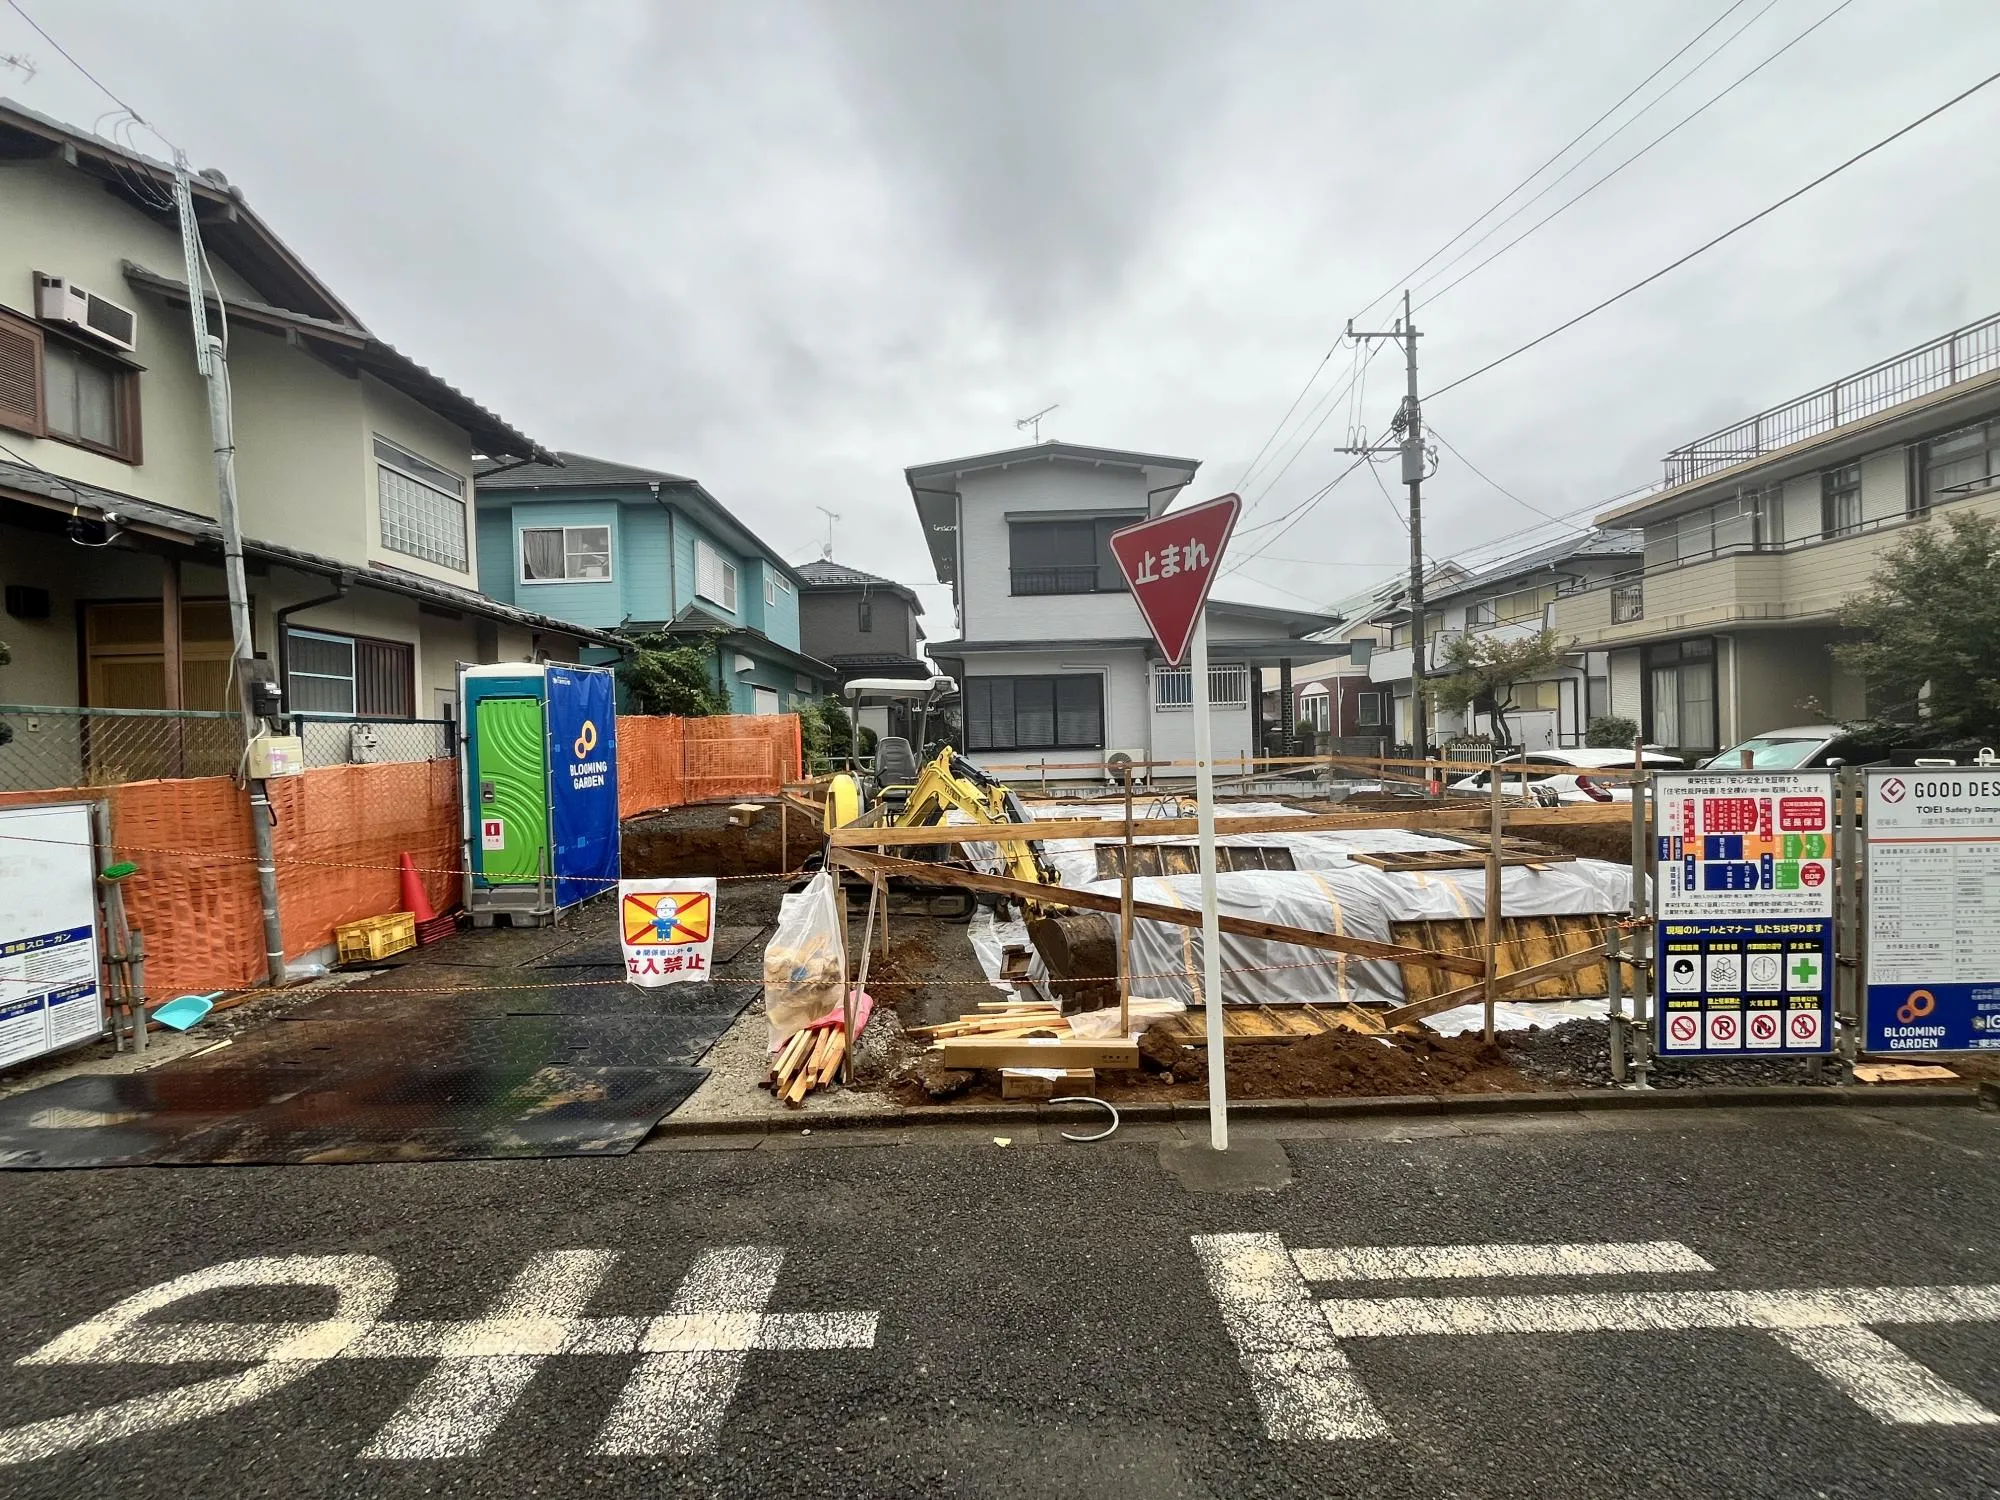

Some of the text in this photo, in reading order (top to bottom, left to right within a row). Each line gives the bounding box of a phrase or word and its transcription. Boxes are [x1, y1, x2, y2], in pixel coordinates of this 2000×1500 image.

[1135, 537, 1210, 585] 止まれ
[570, 760, 607, 777] BLOOMING
[573, 774, 605, 790] GARDEN
[1914, 781, 2000, 798] GOOD DES
[1945, 806, 1972, 814] Safety
[1666, 924, 1823, 935] 現場のルールとマナー 私たちは守ります
[627, 953, 705, 975] 立入禁止
[1884, 1026, 1946, 1038] BLOOMING
[1890, 1038, 1938, 1049] GARDEN
